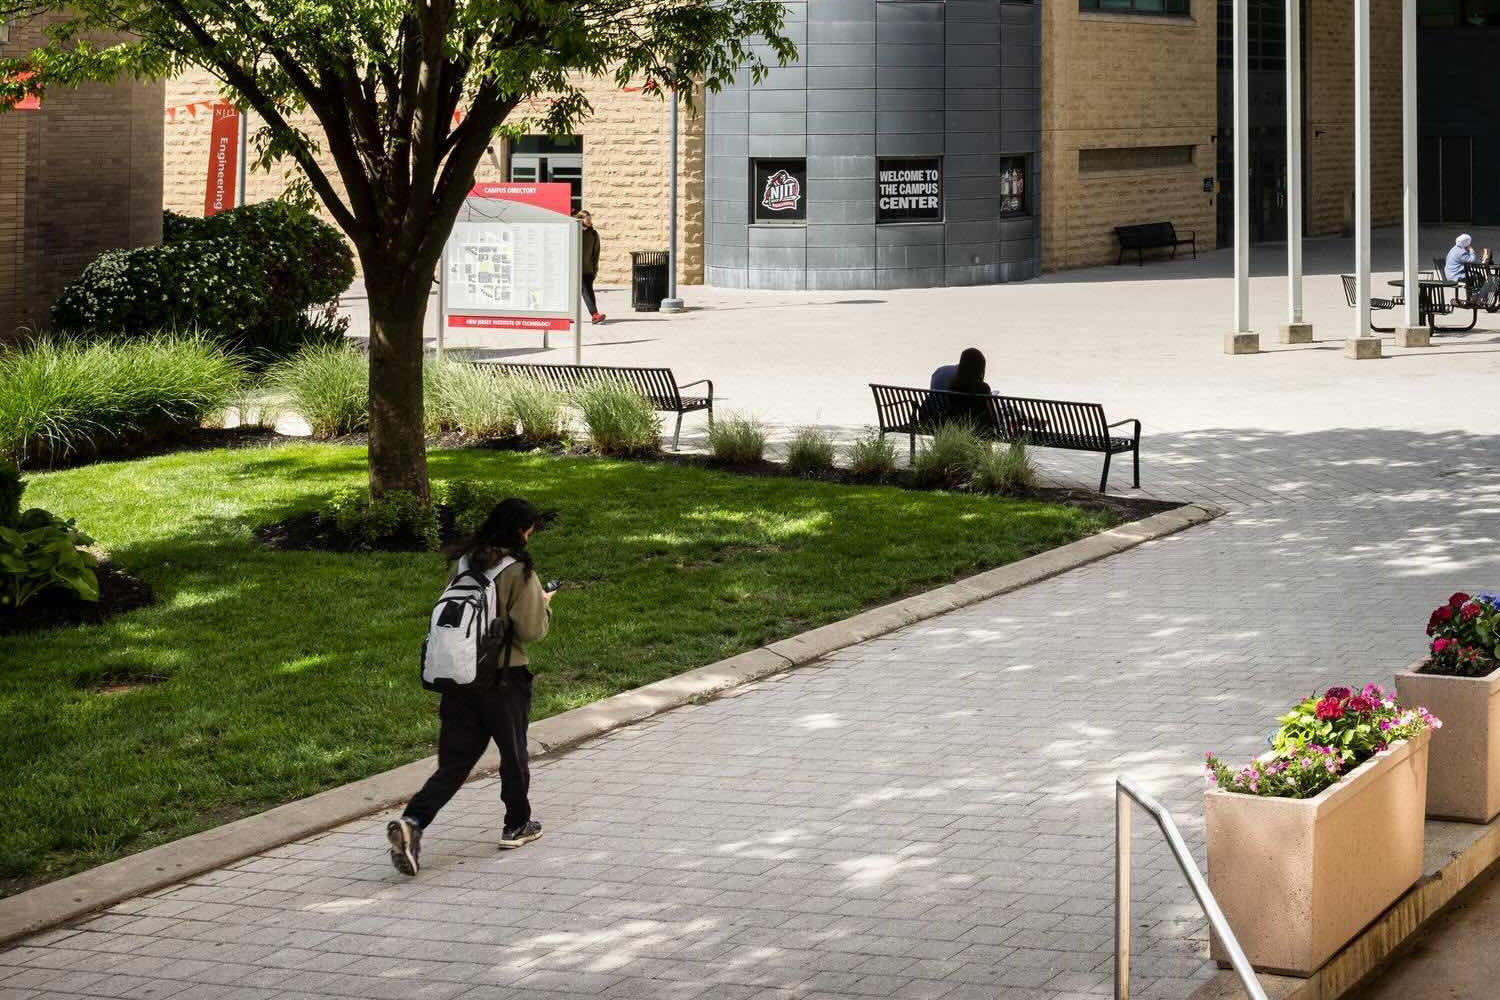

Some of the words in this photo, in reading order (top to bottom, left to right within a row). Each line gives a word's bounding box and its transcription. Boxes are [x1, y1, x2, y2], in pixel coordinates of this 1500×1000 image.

[213, 137, 229, 210] Engineering
[880, 170, 924, 182] WELCOME
[925, 169, 938, 181] TO
[770, 183, 795, 201] NJIT
[880, 183, 898, 195] THE
[899, 183, 938, 195] CAMPUS
[880, 196, 939, 210] CENTER
